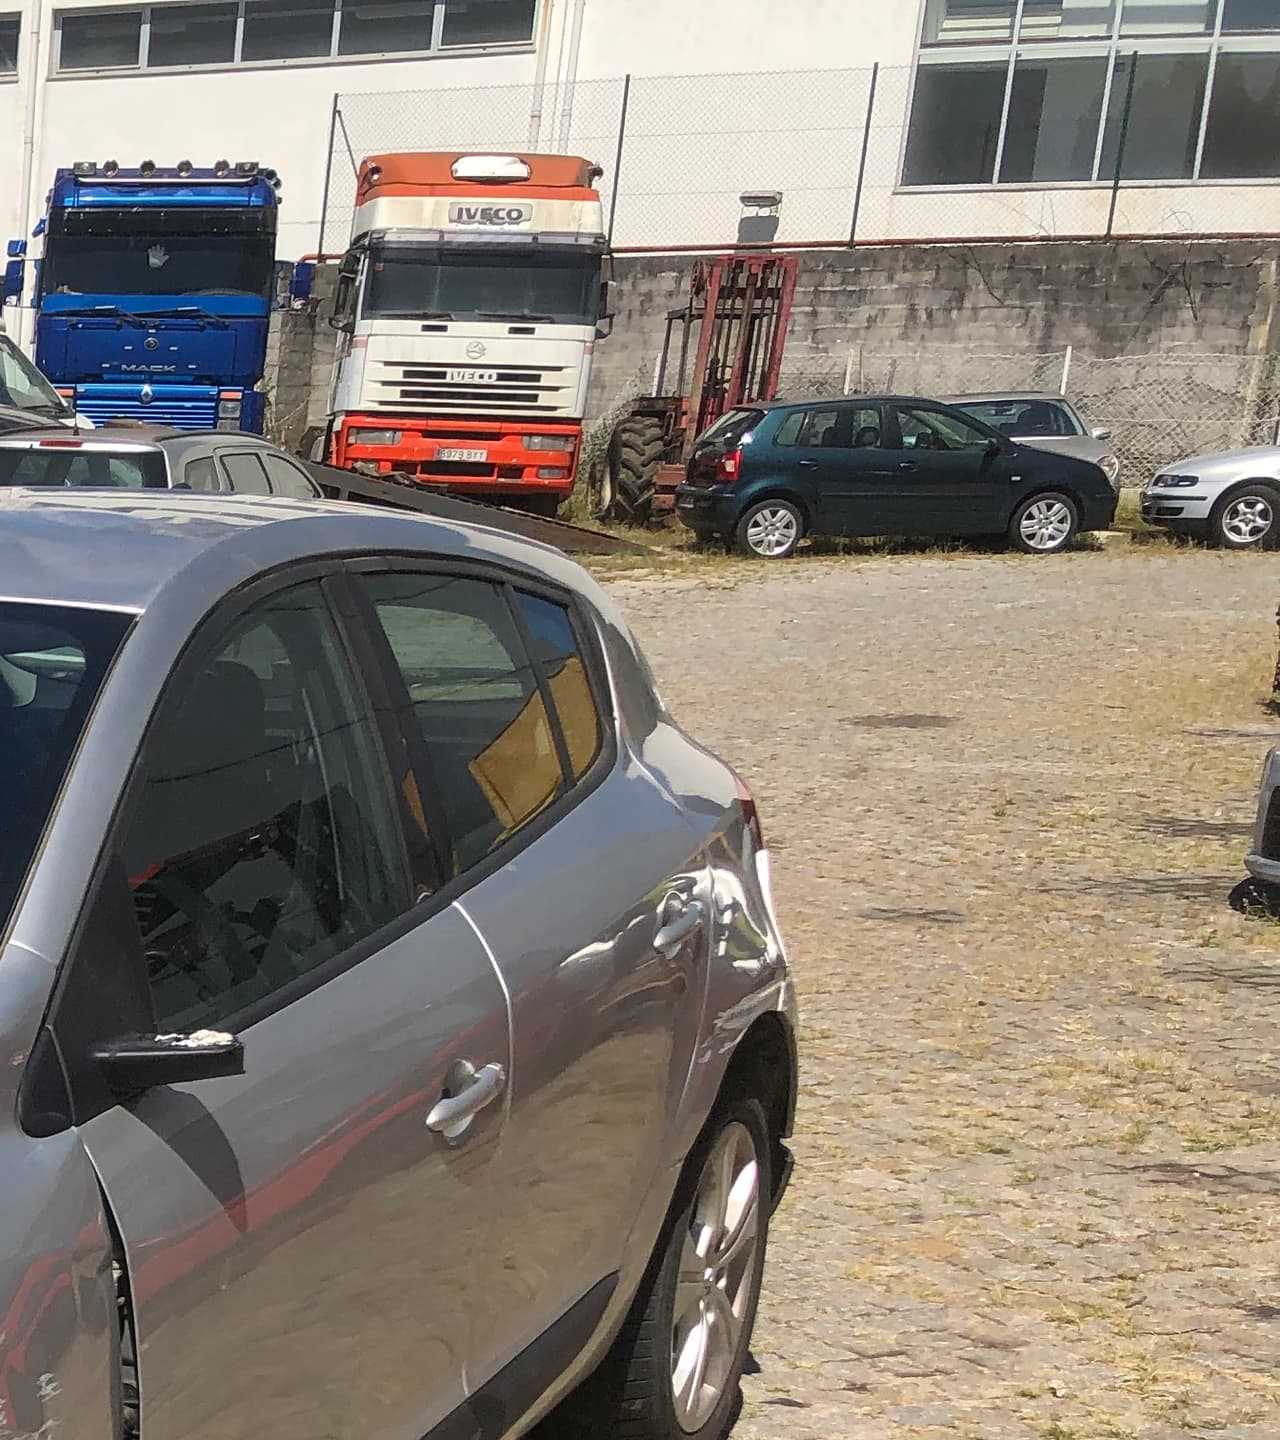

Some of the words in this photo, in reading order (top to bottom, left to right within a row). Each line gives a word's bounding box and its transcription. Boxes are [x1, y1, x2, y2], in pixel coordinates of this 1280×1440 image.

[457, 207, 523, 221] IVECO
[121, 364, 177, 373] MACK
[446, 370, 496, 382] IVECO
